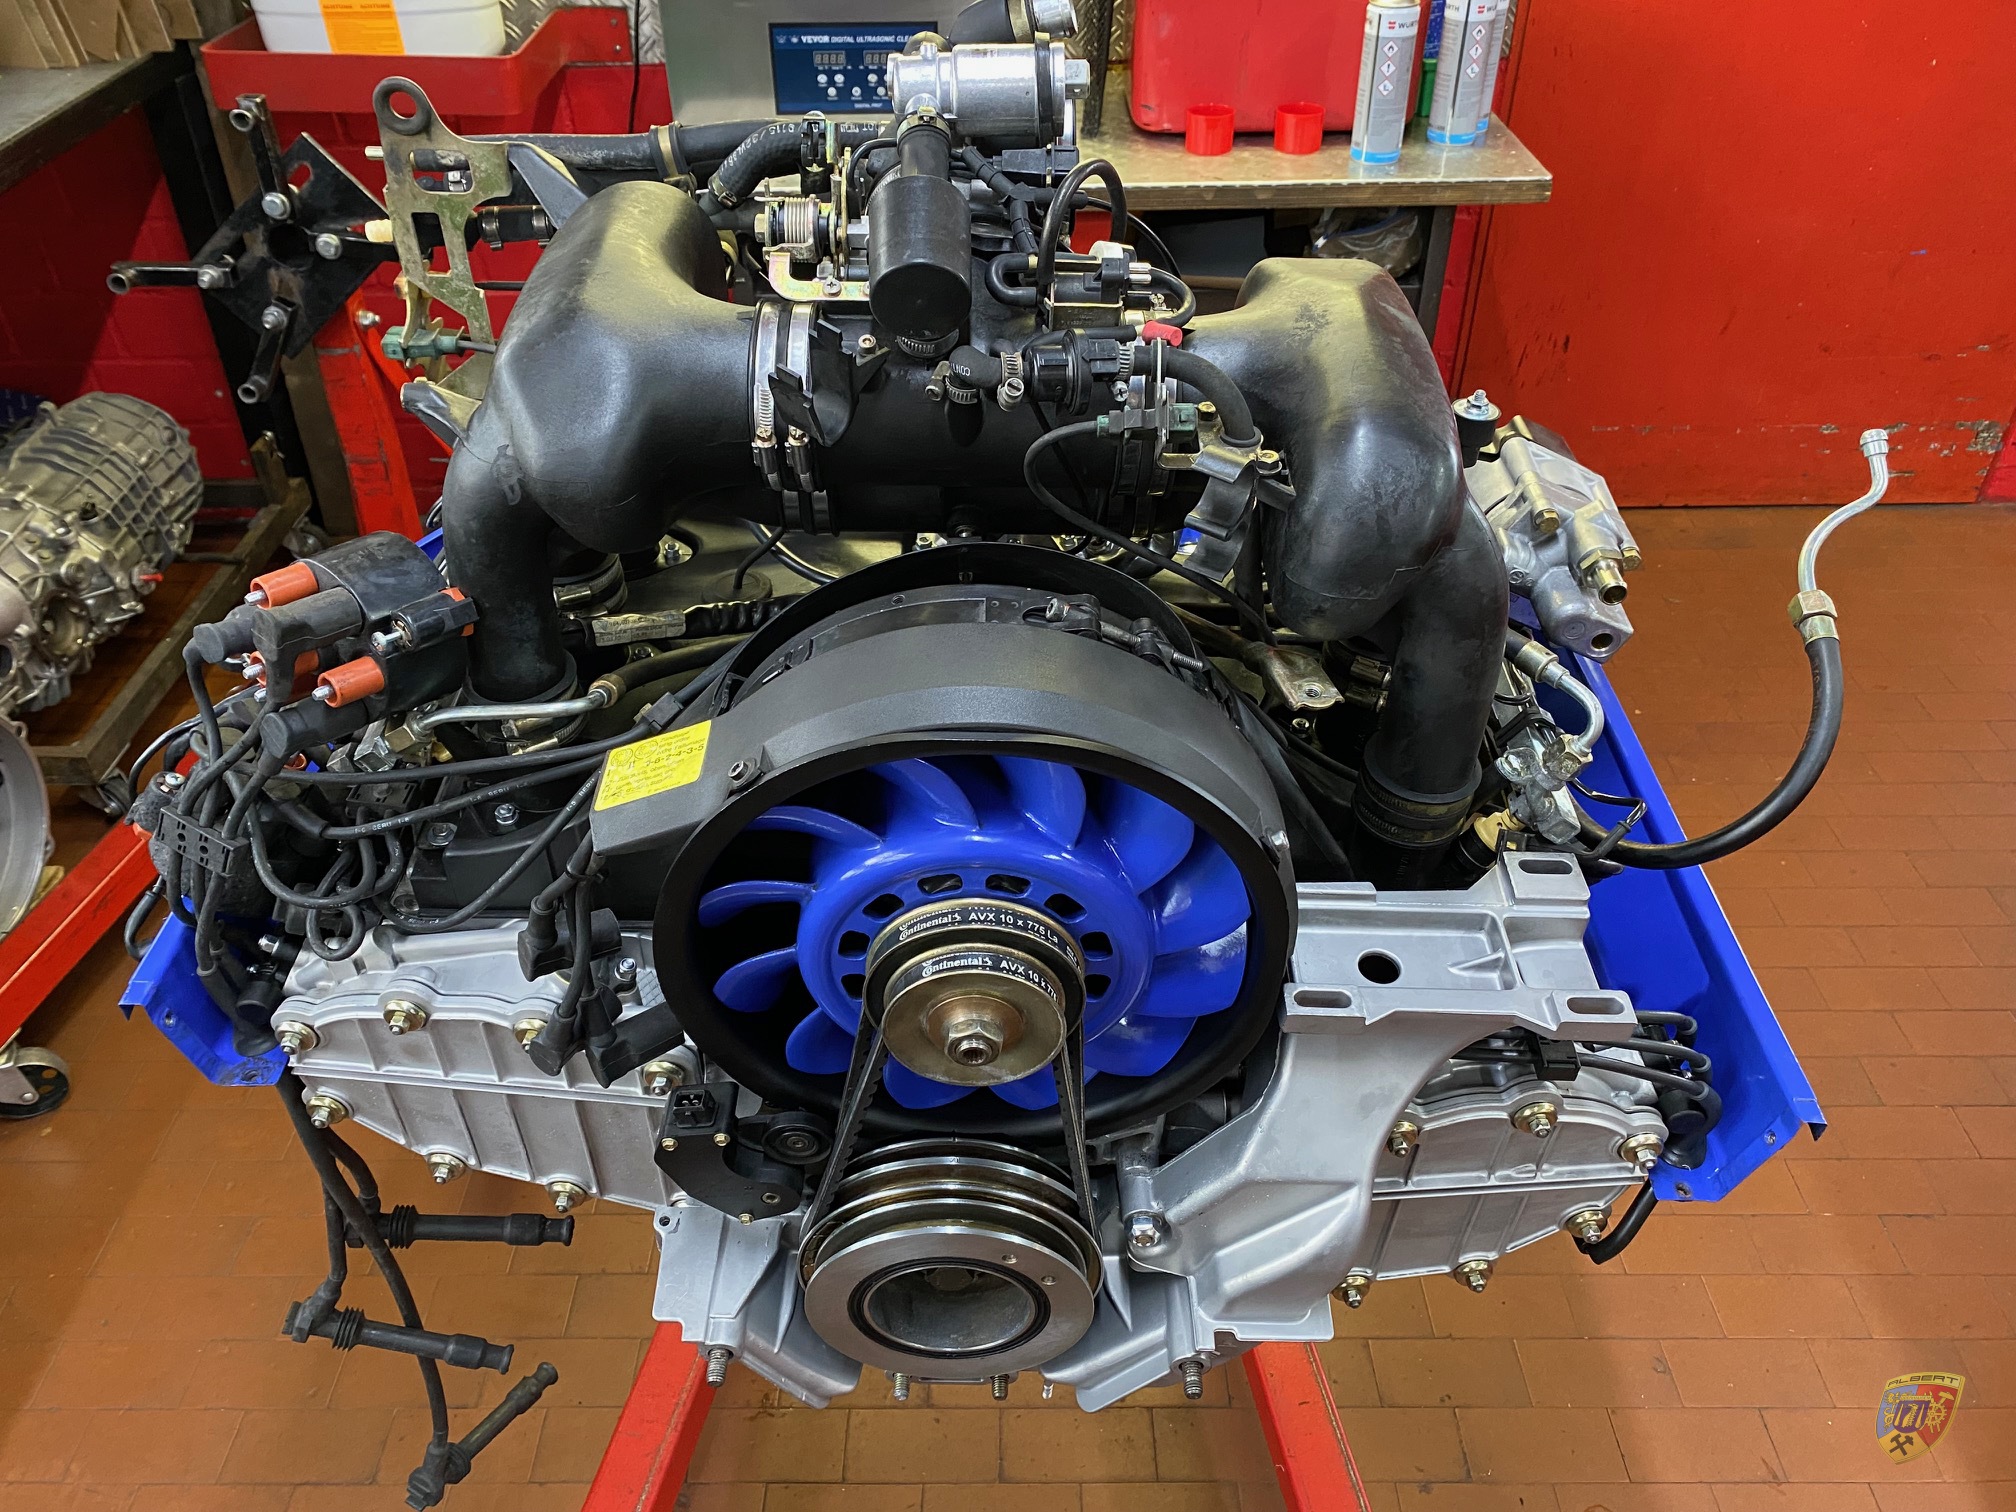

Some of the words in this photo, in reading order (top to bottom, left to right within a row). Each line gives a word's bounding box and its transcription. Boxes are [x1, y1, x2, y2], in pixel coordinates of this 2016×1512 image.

[801, 35, 830, 43] VEVOR
[856, 35, 895, 43] ULTRASONIC
[899, 914, 952, 941] Continental
[968, 912, 996, 922] AVX
[999, 913, 1014, 926] 10
[1016, 919, 1024, 927] x
[1027, 920, 1046, 936] 775
[922, 956, 983, 977] Continental
[1000, 958, 1026, 976] AVX
[1028, 969, 1039, 983] 10
